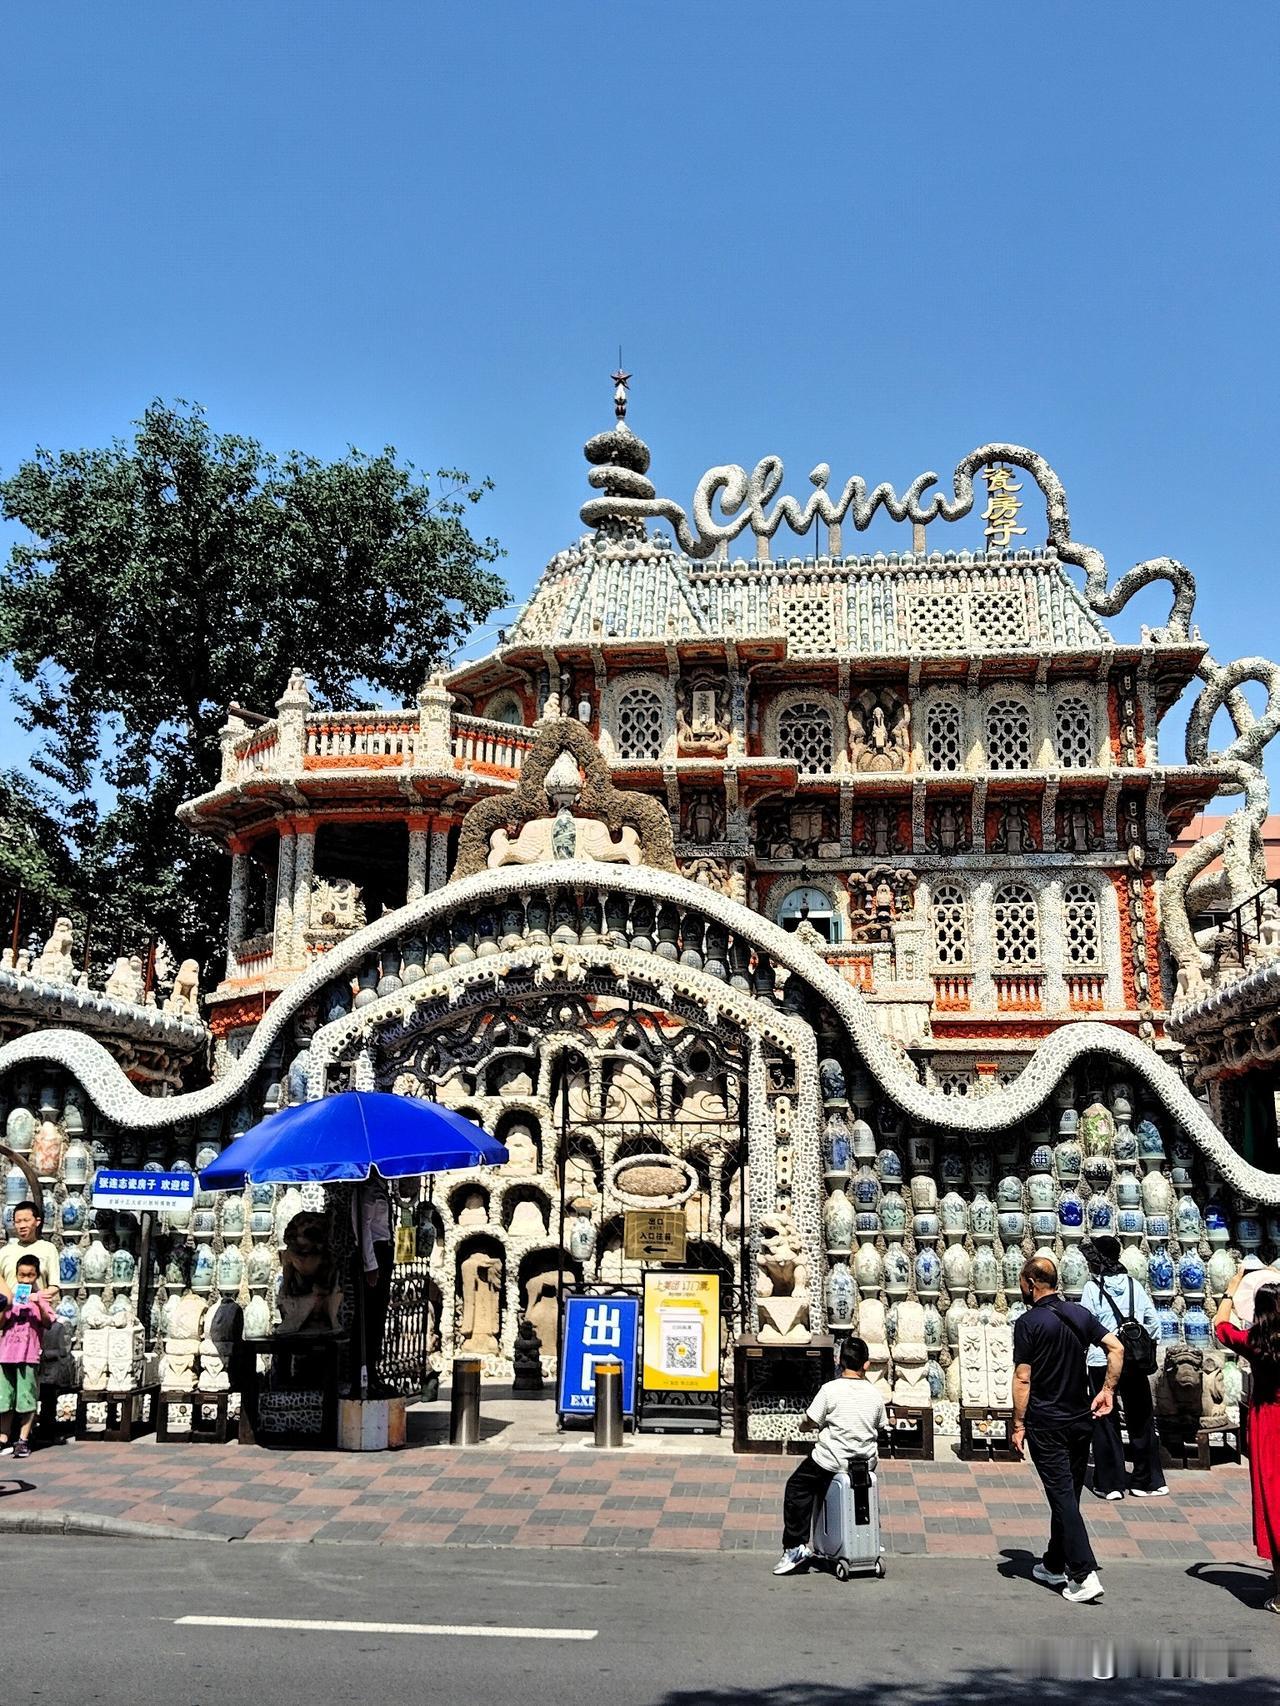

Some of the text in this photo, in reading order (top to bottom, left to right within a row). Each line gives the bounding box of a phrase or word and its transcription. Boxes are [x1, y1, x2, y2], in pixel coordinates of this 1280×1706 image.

[693, 455, 974, 545] China
[981, 468, 1028, 546] 瓷房子
[160, 1180, 190, 1191] 欢迎您
[648, 1217, 664, 1225] 出口
[582, 1304, 624, 1391] 出口
